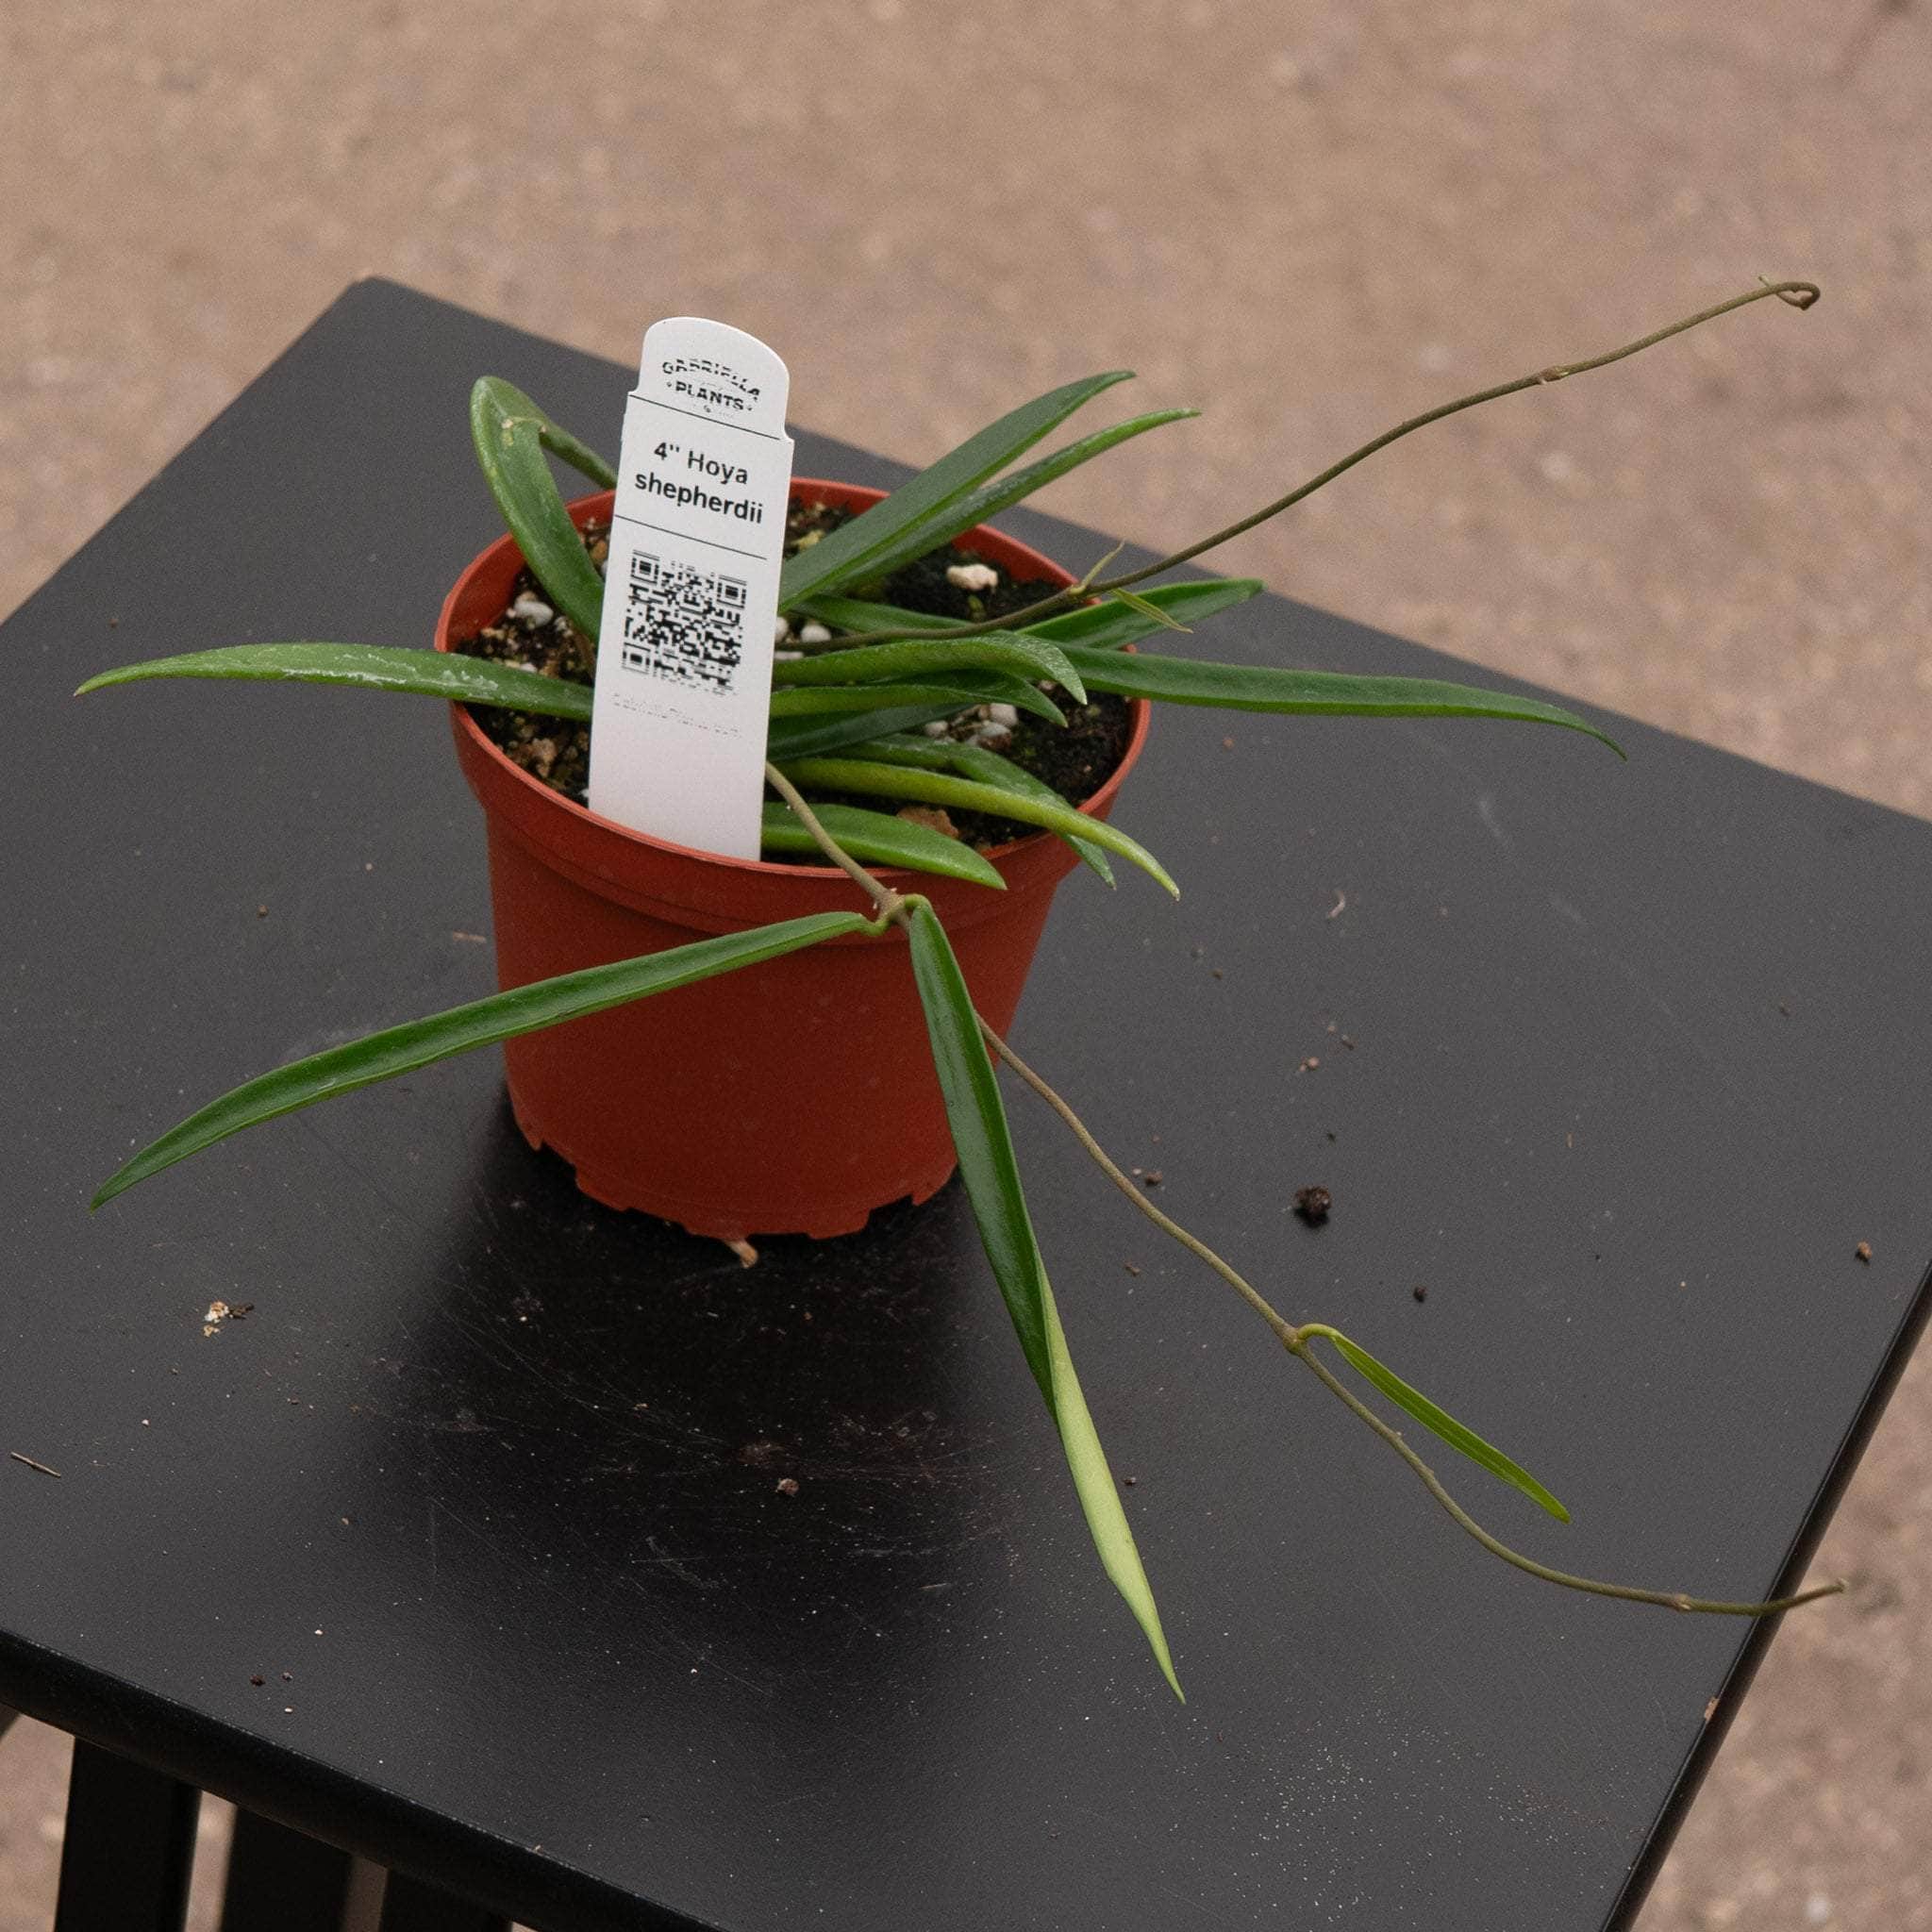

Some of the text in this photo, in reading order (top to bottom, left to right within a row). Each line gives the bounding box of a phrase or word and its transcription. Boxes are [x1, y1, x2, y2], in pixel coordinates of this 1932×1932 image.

[675, 380, 744, 410] PLANTS
[688, 450, 748, 485] Hoya
[635, 472, 763, 524] shepherdii
